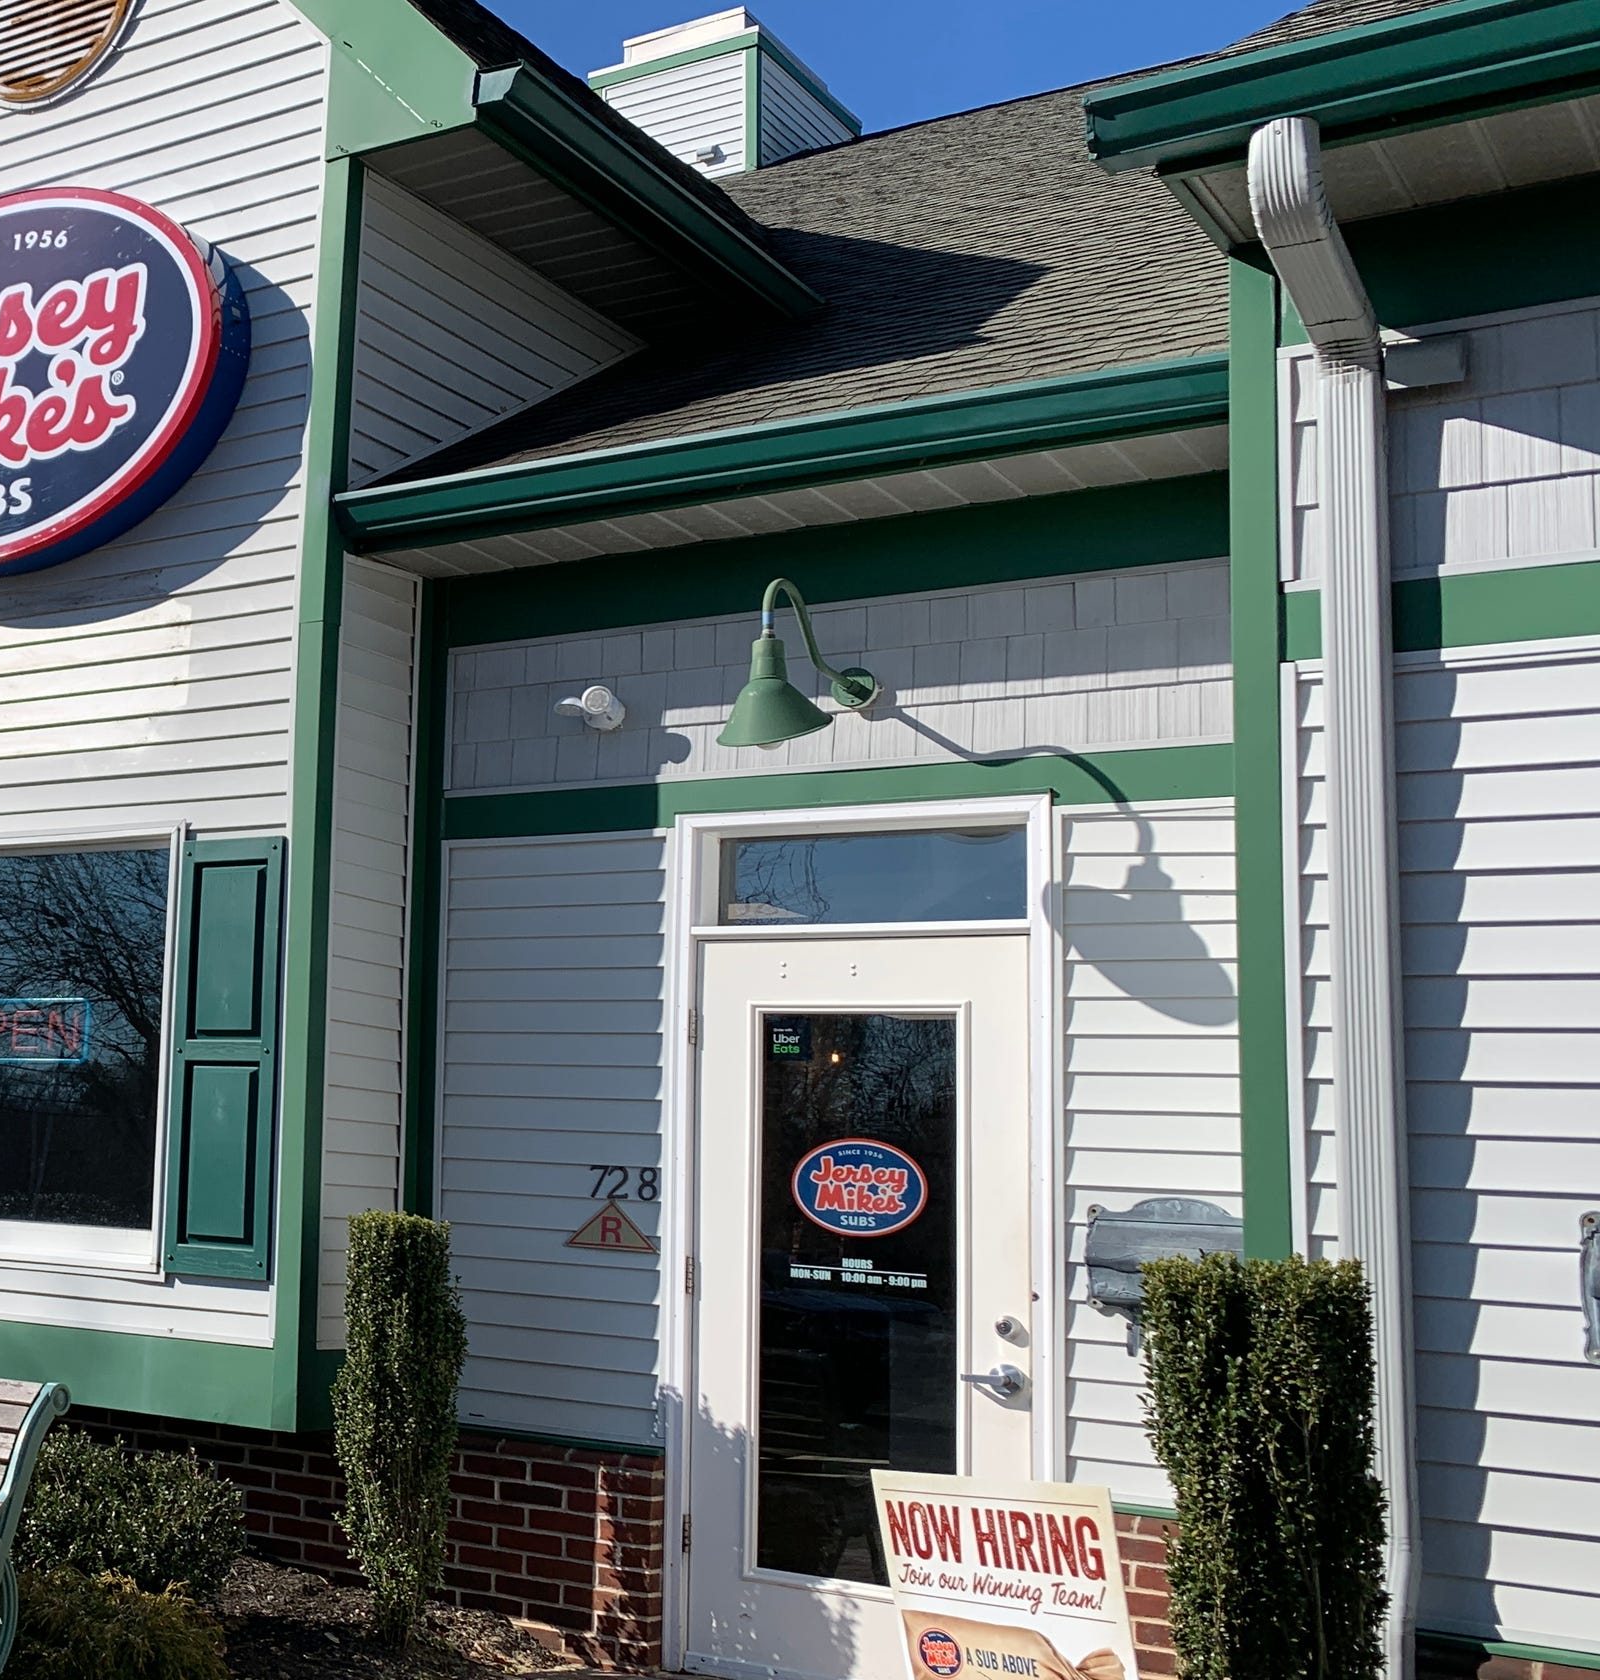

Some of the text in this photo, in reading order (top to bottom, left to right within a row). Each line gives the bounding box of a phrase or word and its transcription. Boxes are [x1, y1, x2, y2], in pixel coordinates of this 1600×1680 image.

[12, 229, 69, 252] 1956
[773, 1033, 800, 1043] Uber
[773, 1044, 800, 1053] Eats
[838, 1149, 860, 1157] SINCE
[590, 1165, 658, 1201] 728
[811, 1157, 907, 1194] Jersey
[816, 1183, 905, 1213] Mike's
[600, 1216, 622, 1243] R
[840, 1215, 876, 1227] SUBS
[841, 1257, 873, 1269] HOURS
[790, 1268, 831, 1280] MON-SUN
[841, 1272, 866, 1283] 10:00
[867, 1275, 883, 1285] am
[888, 1276, 910, 1287] 9:00
[911, 1279, 927, 1289] pm
[885, 1499, 1107, 1581] NOW HIRING
[898, 1562, 1107, 1615] Join our Winning Team!
[965, 1647, 1040, 1678] A SUB ABOVE
